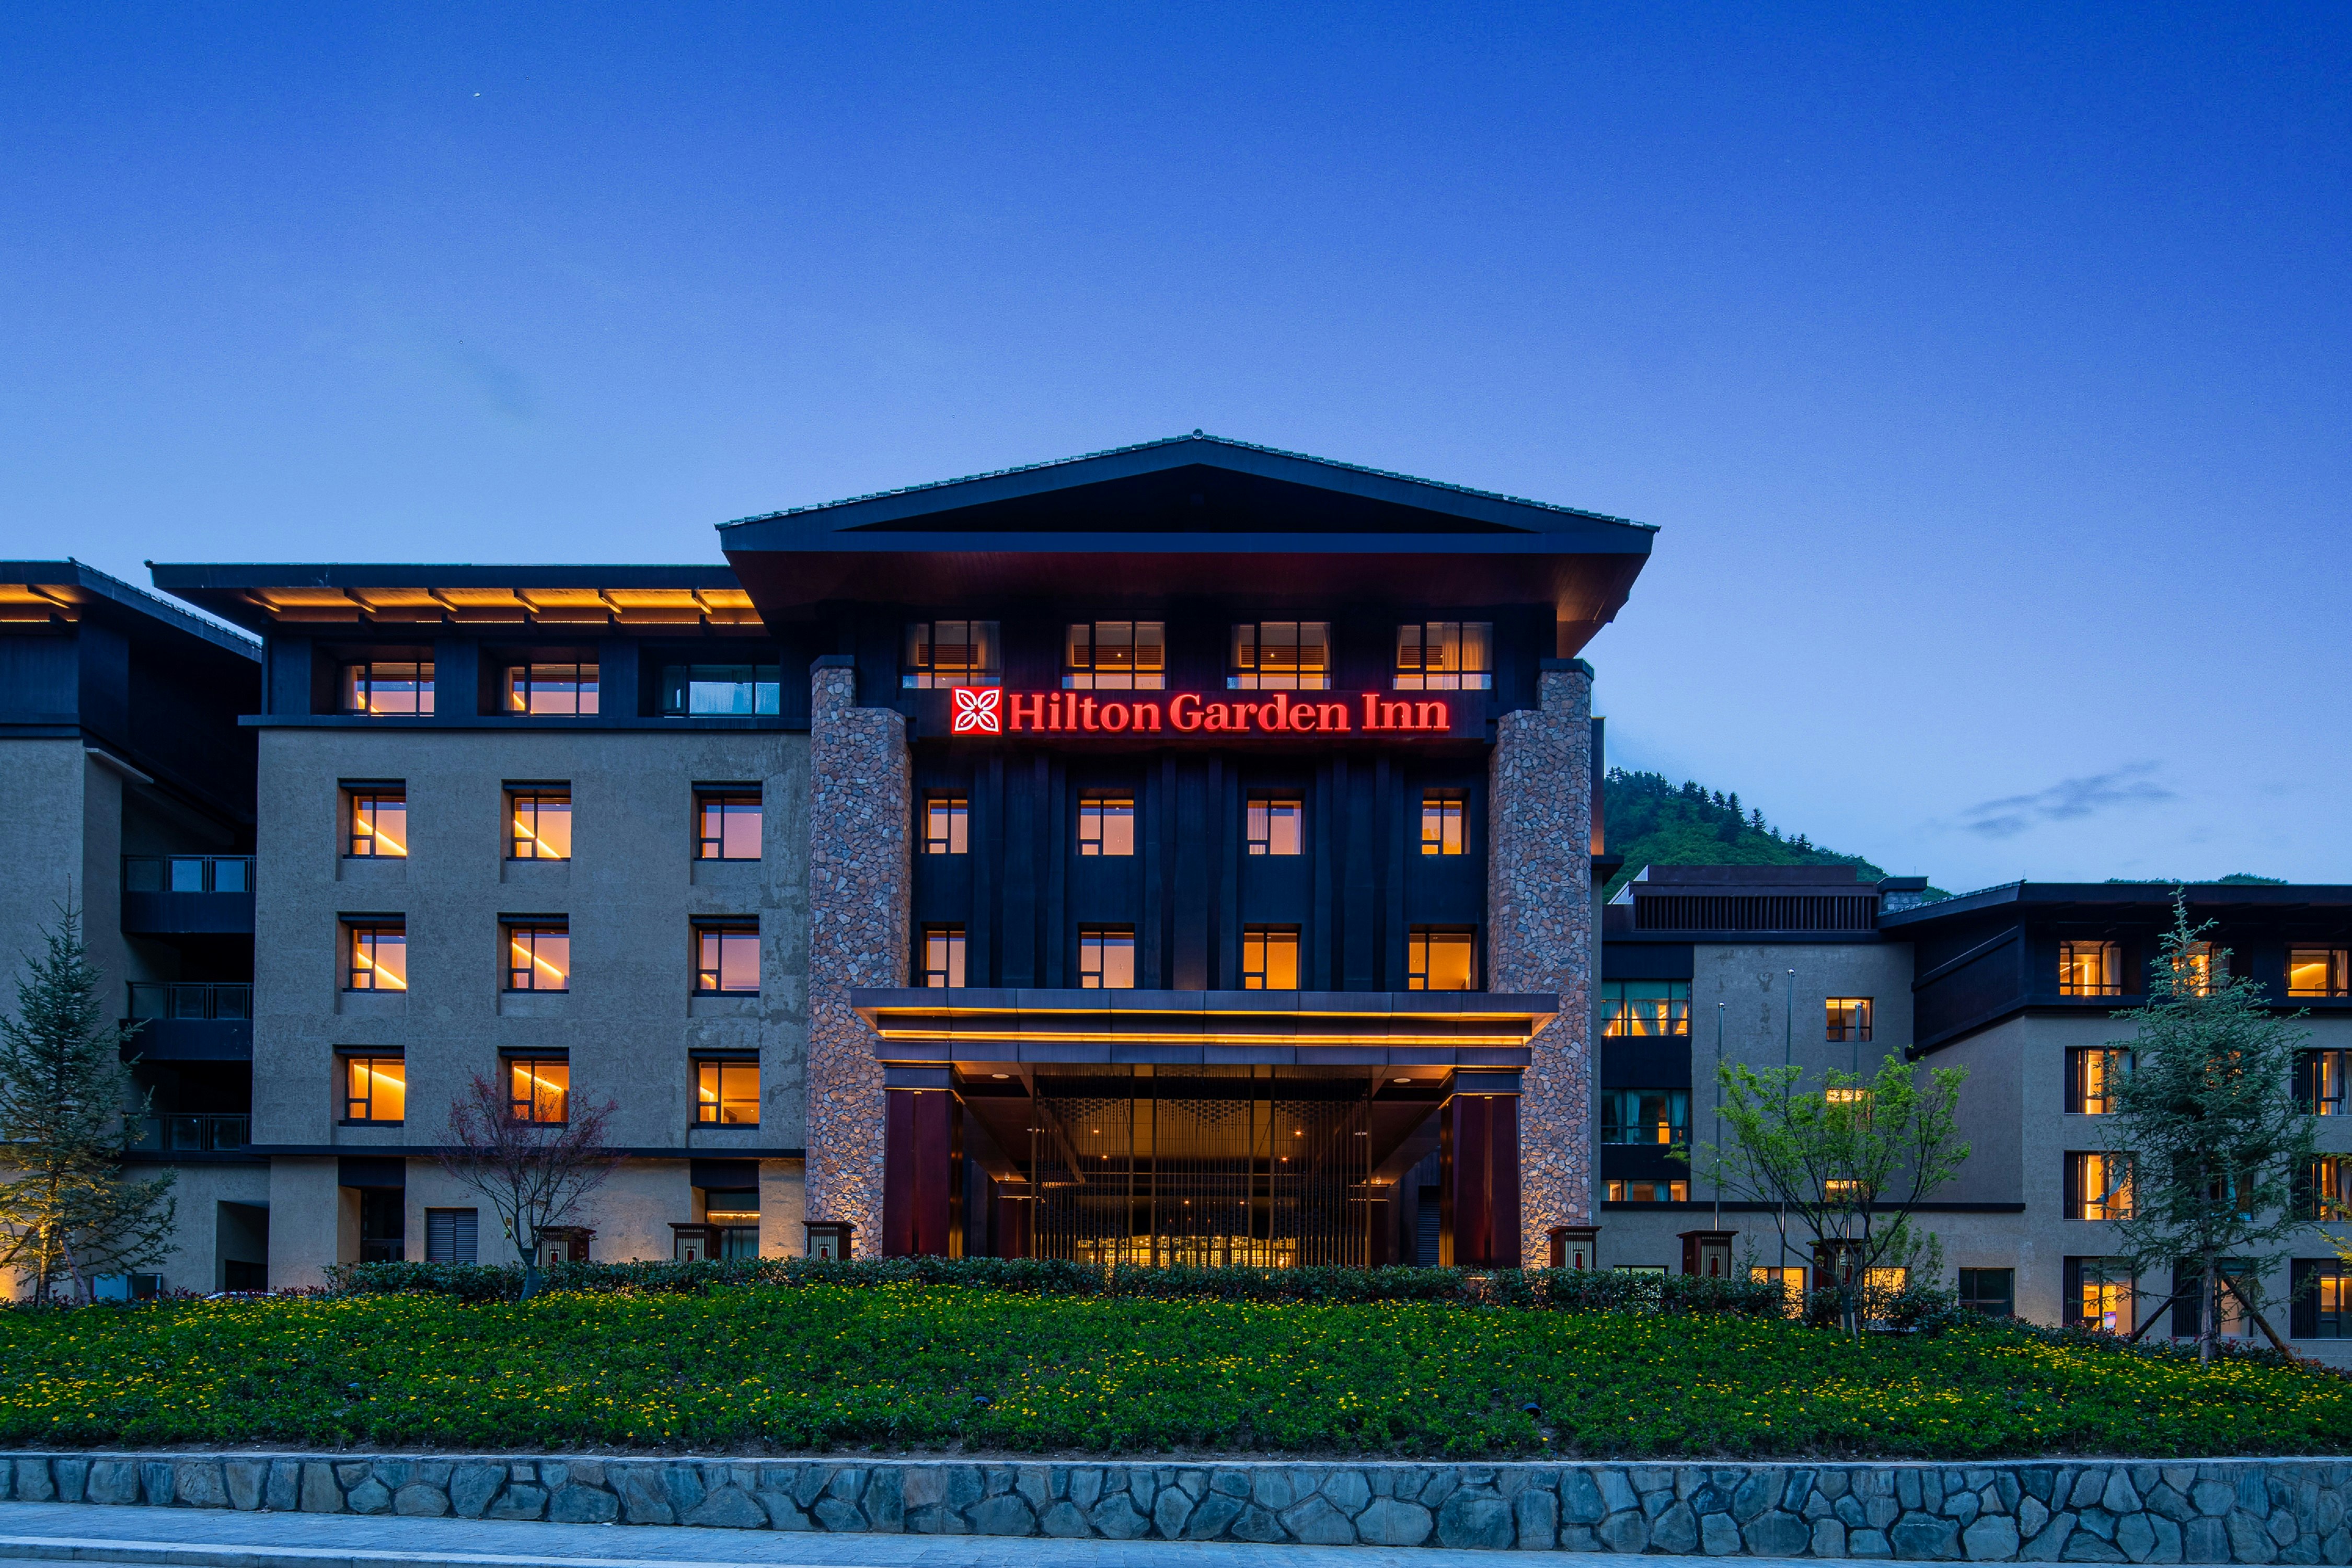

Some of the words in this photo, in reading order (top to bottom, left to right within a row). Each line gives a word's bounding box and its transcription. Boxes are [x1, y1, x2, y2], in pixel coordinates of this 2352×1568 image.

[1009, 693, 1161, 731] Hilton
[1169, 694, 1351, 731] Garden
[1362, 694, 1450, 731] Inn
